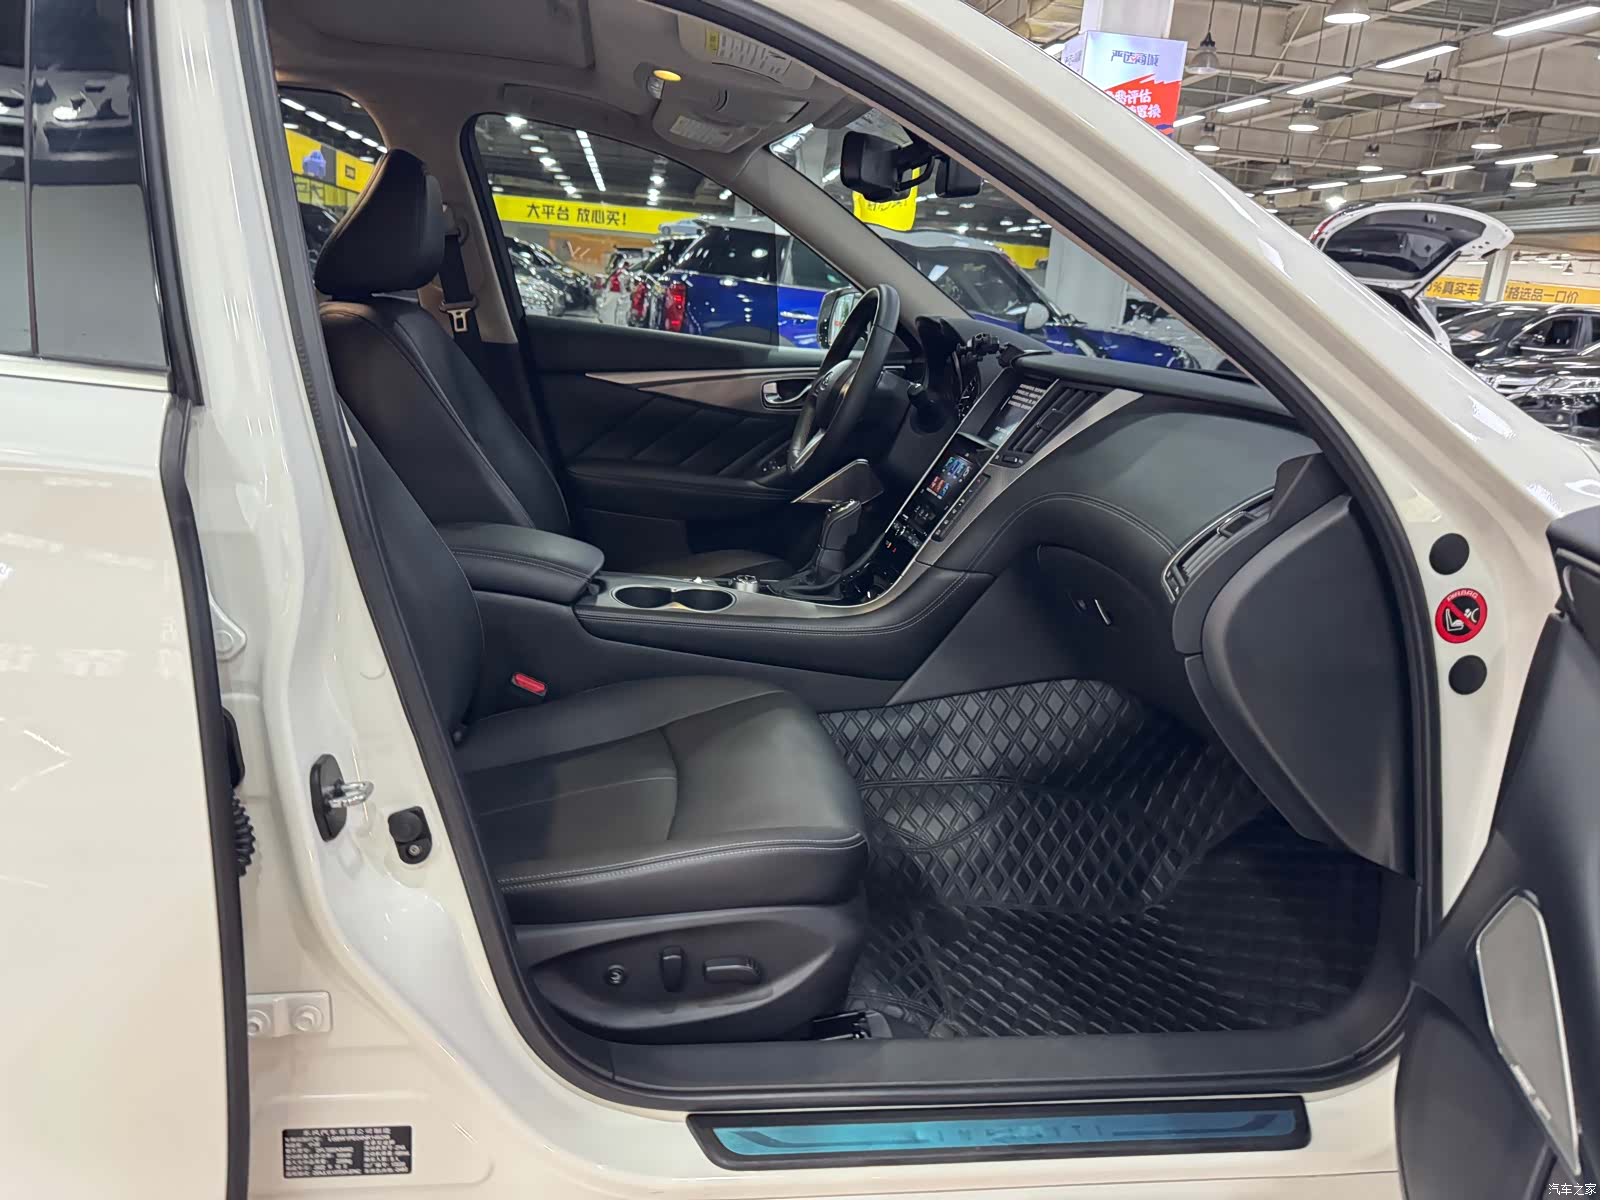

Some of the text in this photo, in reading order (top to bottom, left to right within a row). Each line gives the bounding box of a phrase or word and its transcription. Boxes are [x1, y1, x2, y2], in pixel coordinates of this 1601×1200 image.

[526, 203, 570, 221] 大平台
[1447, 590, 1479, 602] AIRBAG
